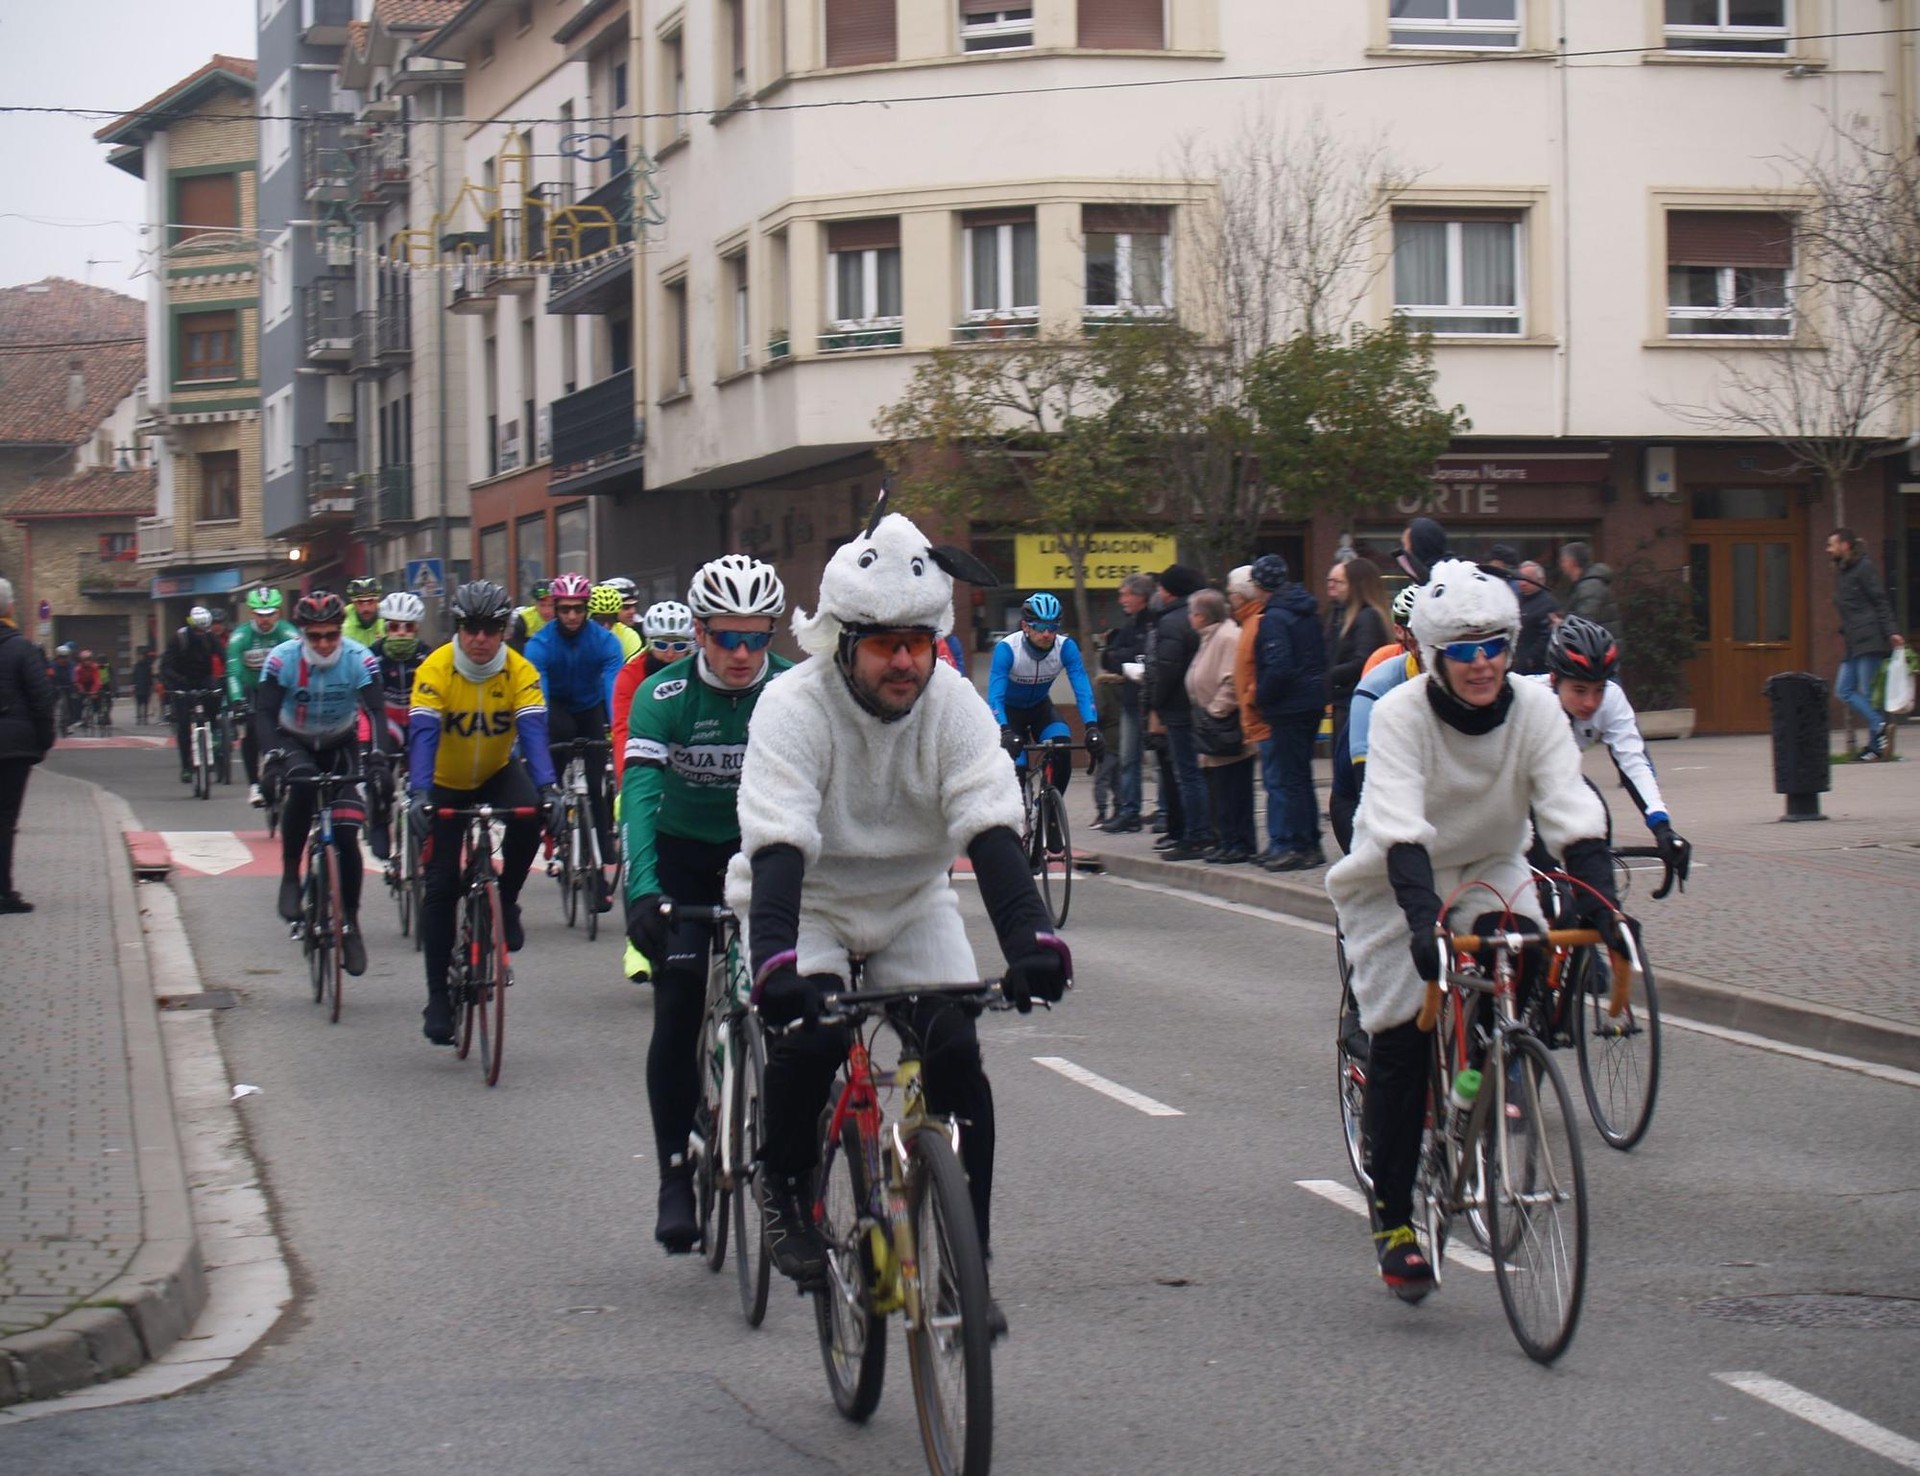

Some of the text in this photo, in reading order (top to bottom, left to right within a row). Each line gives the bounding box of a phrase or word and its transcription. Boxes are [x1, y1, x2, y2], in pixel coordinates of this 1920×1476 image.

[1395, 482, 1500, 514] ORTE
[1039, 537, 1153, 554] LIDACIÓN
[444, 711, 511, 737] KAS
[674, 750, 716, 768] CAJA
[720, 752, 745, 770] RU
